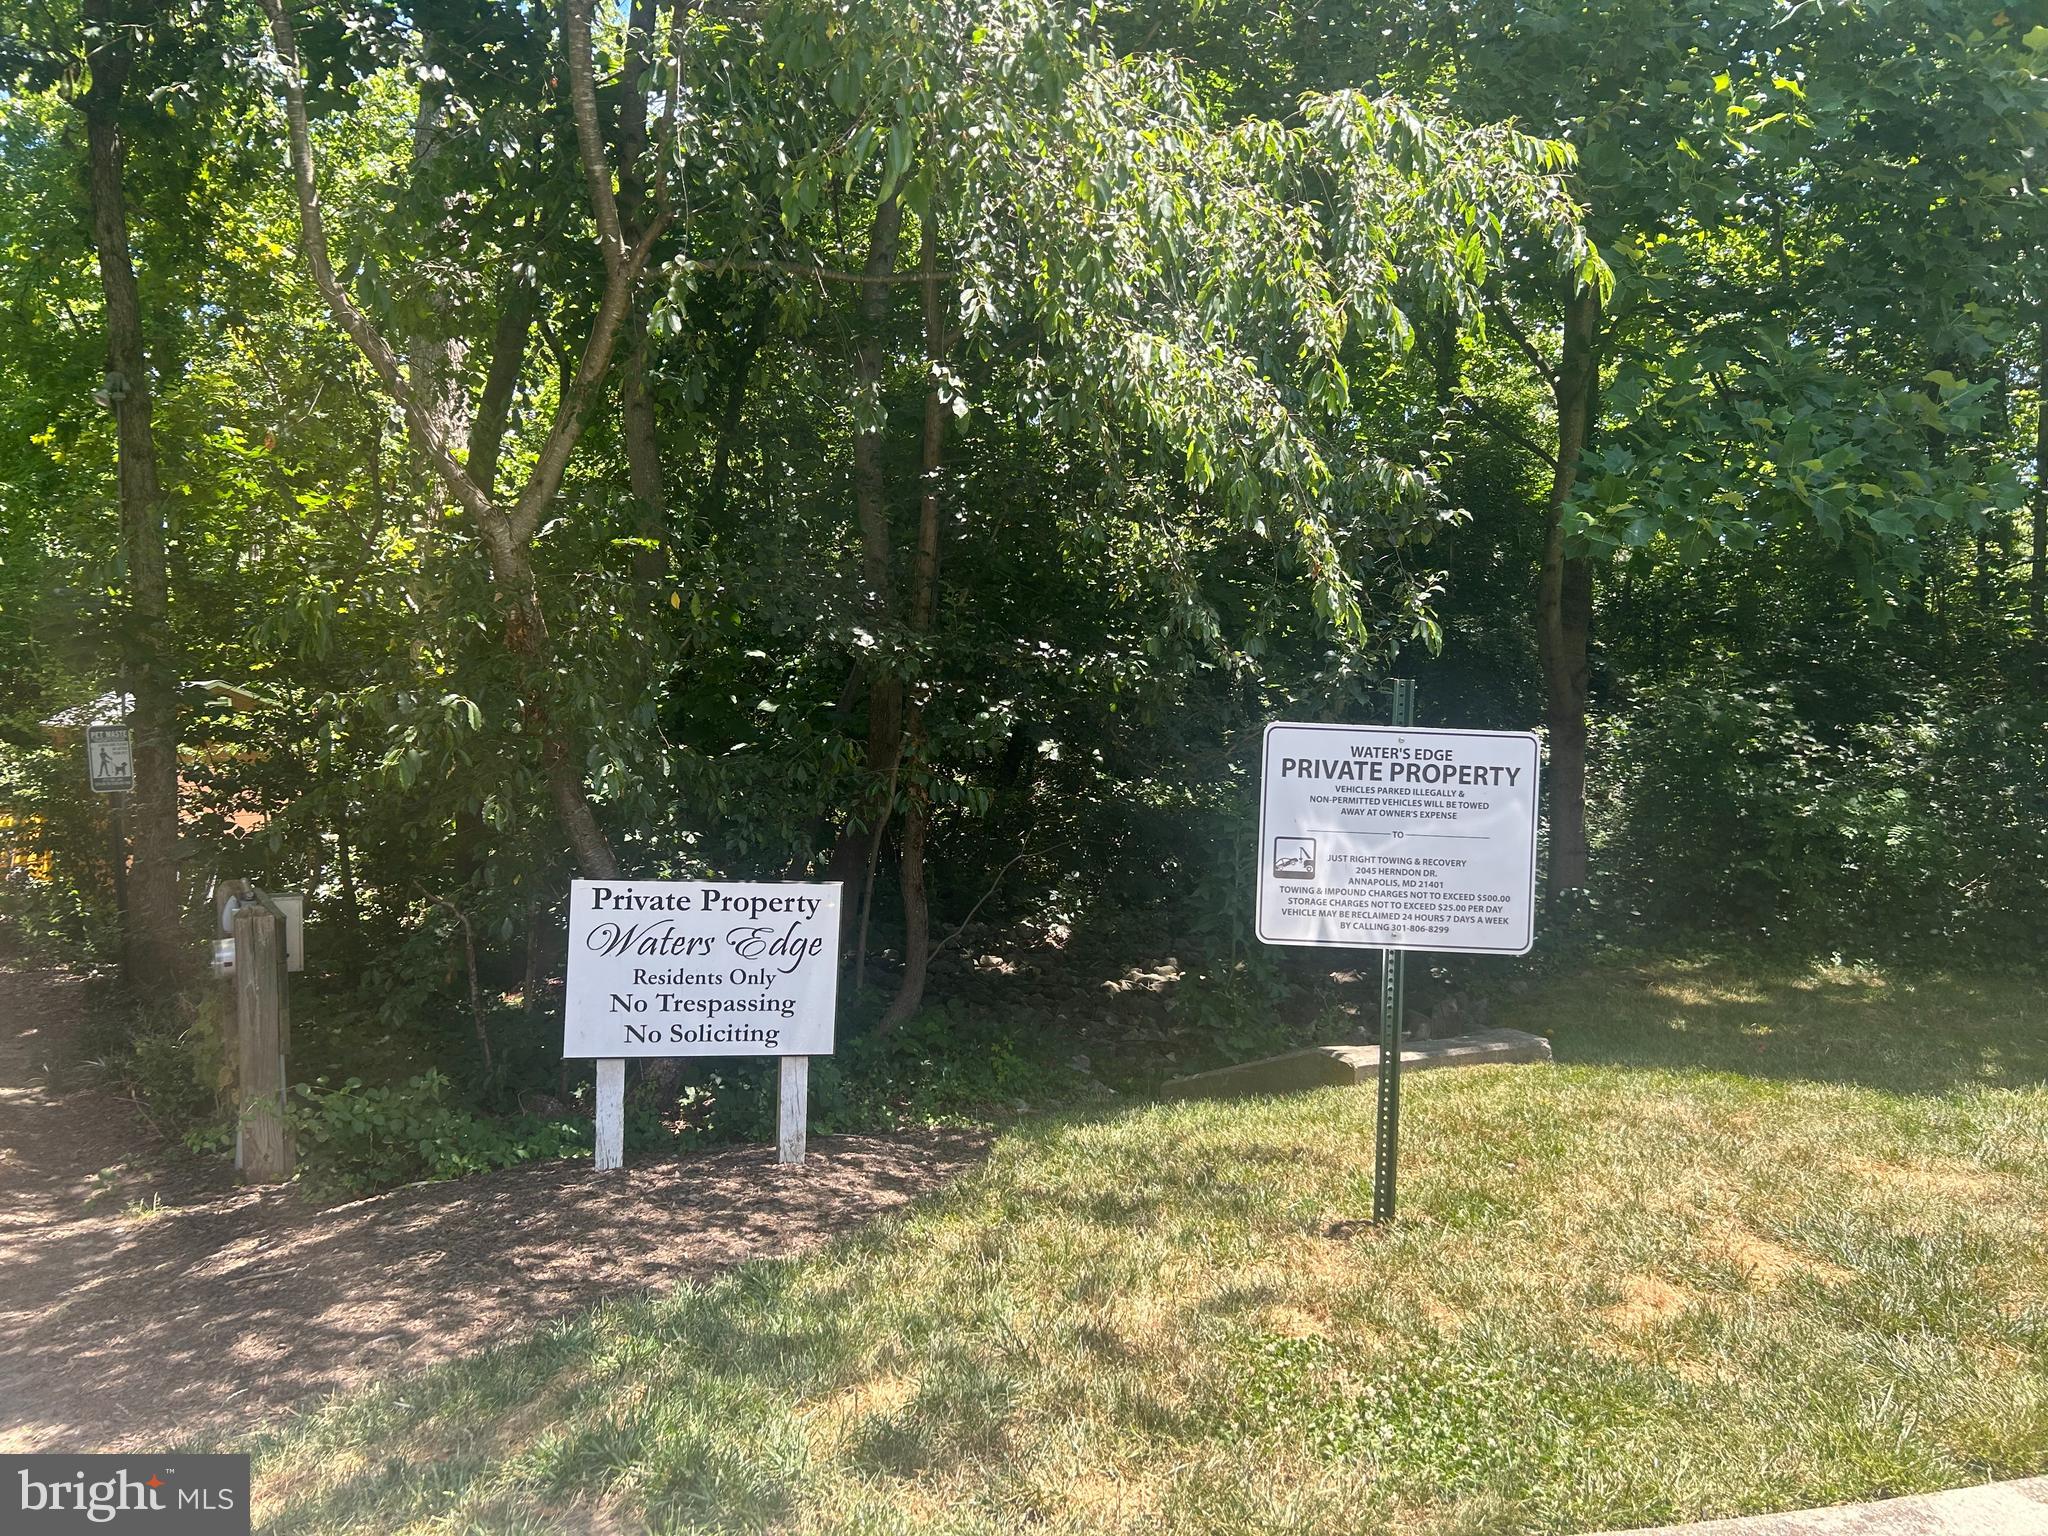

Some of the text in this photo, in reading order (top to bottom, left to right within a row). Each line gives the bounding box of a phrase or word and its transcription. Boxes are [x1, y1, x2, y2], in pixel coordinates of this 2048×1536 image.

[1351, 746, 1452, 761] WATER'S EDGE
[1281, 758, 1520, 786] PRIVATE PROPERTY
[1335, 785, 1376, 794] VEHICLES
[1377, 787, 1410, 796] PARKED
[1413, 788, 1456, 797] ILLEGALLY
[1310, 796, 1380, 805] NON-PERMITTED
[1382, 798, 1422, 807] VEHICLES
[1423, 800, 1444, 808] WILL
[1458, 801, 1489, 810] TOWED
[1341, 808, 1457, 819] AWAY AT OWNER'S EXPENSE
[1392, 831, 1404, 839] TO
[1328, 855, 1466, 867] JUST RIGHT TOWING & RECOVERY
[1356, 867, 1437, 877] 2045 HERNDON DR.
[1348, 878, 1400, 887] ANNAPOLIS,
[1418, 880, 1444, 888] 21401
[1280, 886, 1511, 902] TOWING & IMPOUND CHARGES NOT TO EXCEED $500.00
[592, 887, 821, 920] Private Property
[1288, 897, 1503, 914] STORAGE CHARGES NOT TO EXCEED $25.00 PER DAY
[1281, 908, 1509, 925] VEHICLE MAY BE RECLAIMED 24 HOURS 7 DAYS A WEEK
[1340, 922, 1449, 933] BY CALLING 301-806-8299
[586, 919, 822, 973] Waters Edge
[633, 969, 776, 989] Residents Only
[610, 993, 796, 1017] No Trespassing
[624, 1024, 779, 1048] No Soliciting
